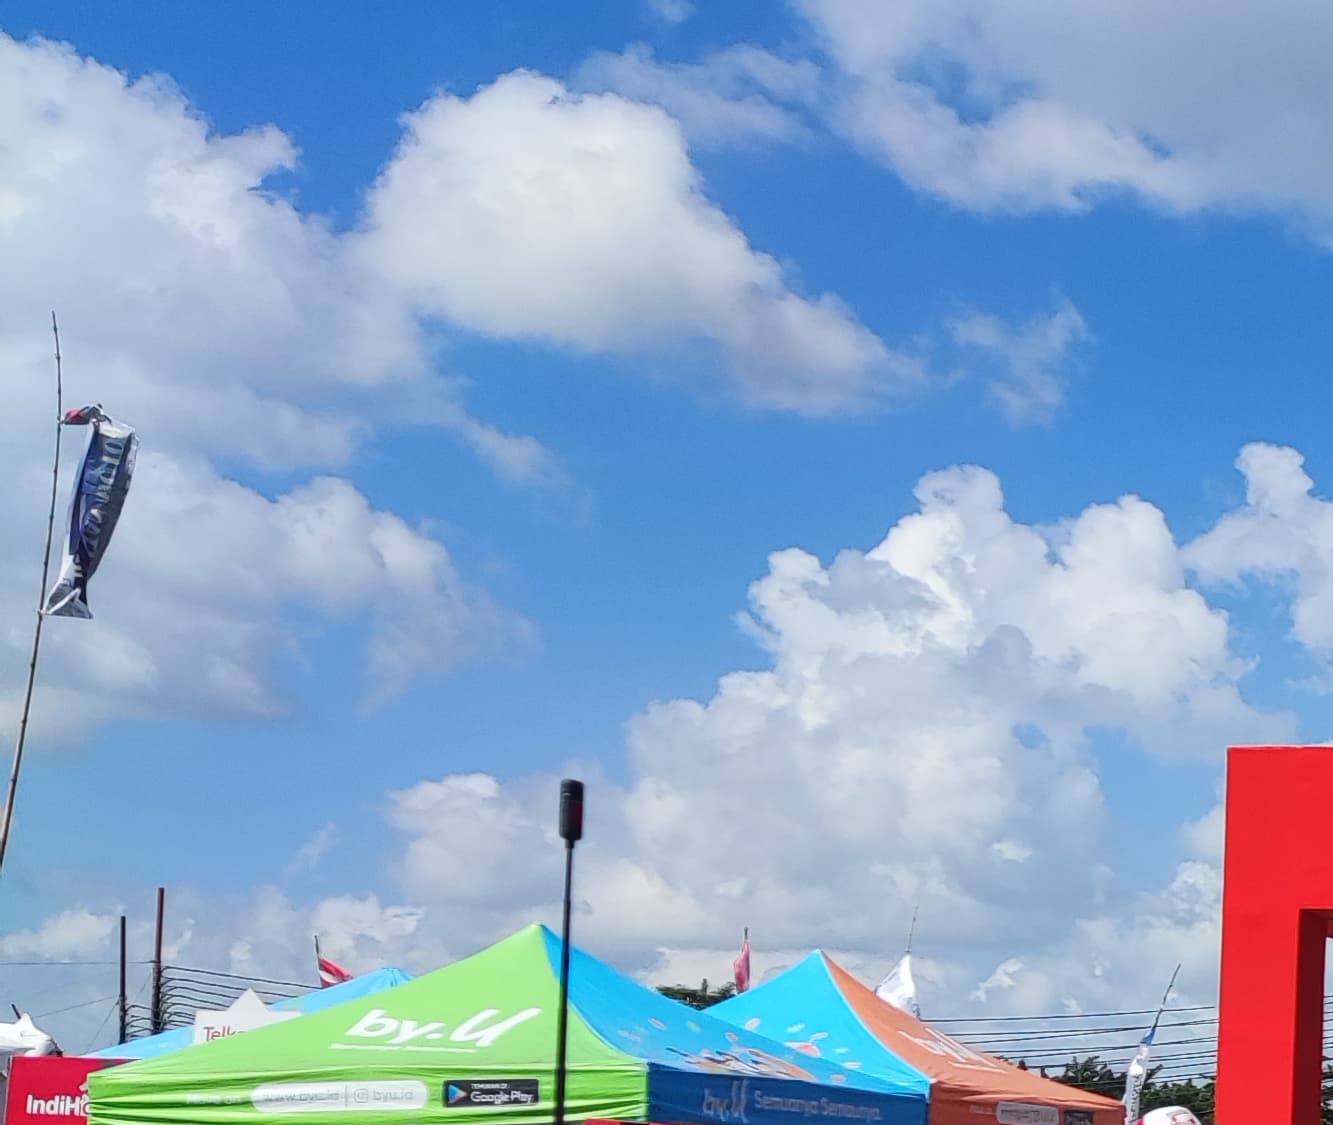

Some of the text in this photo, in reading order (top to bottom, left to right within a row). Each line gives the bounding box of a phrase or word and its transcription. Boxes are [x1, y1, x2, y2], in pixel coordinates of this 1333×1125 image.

[344, 1008, 543, 1047] by.U
[470, 1090, 533, 1104] Google Play
